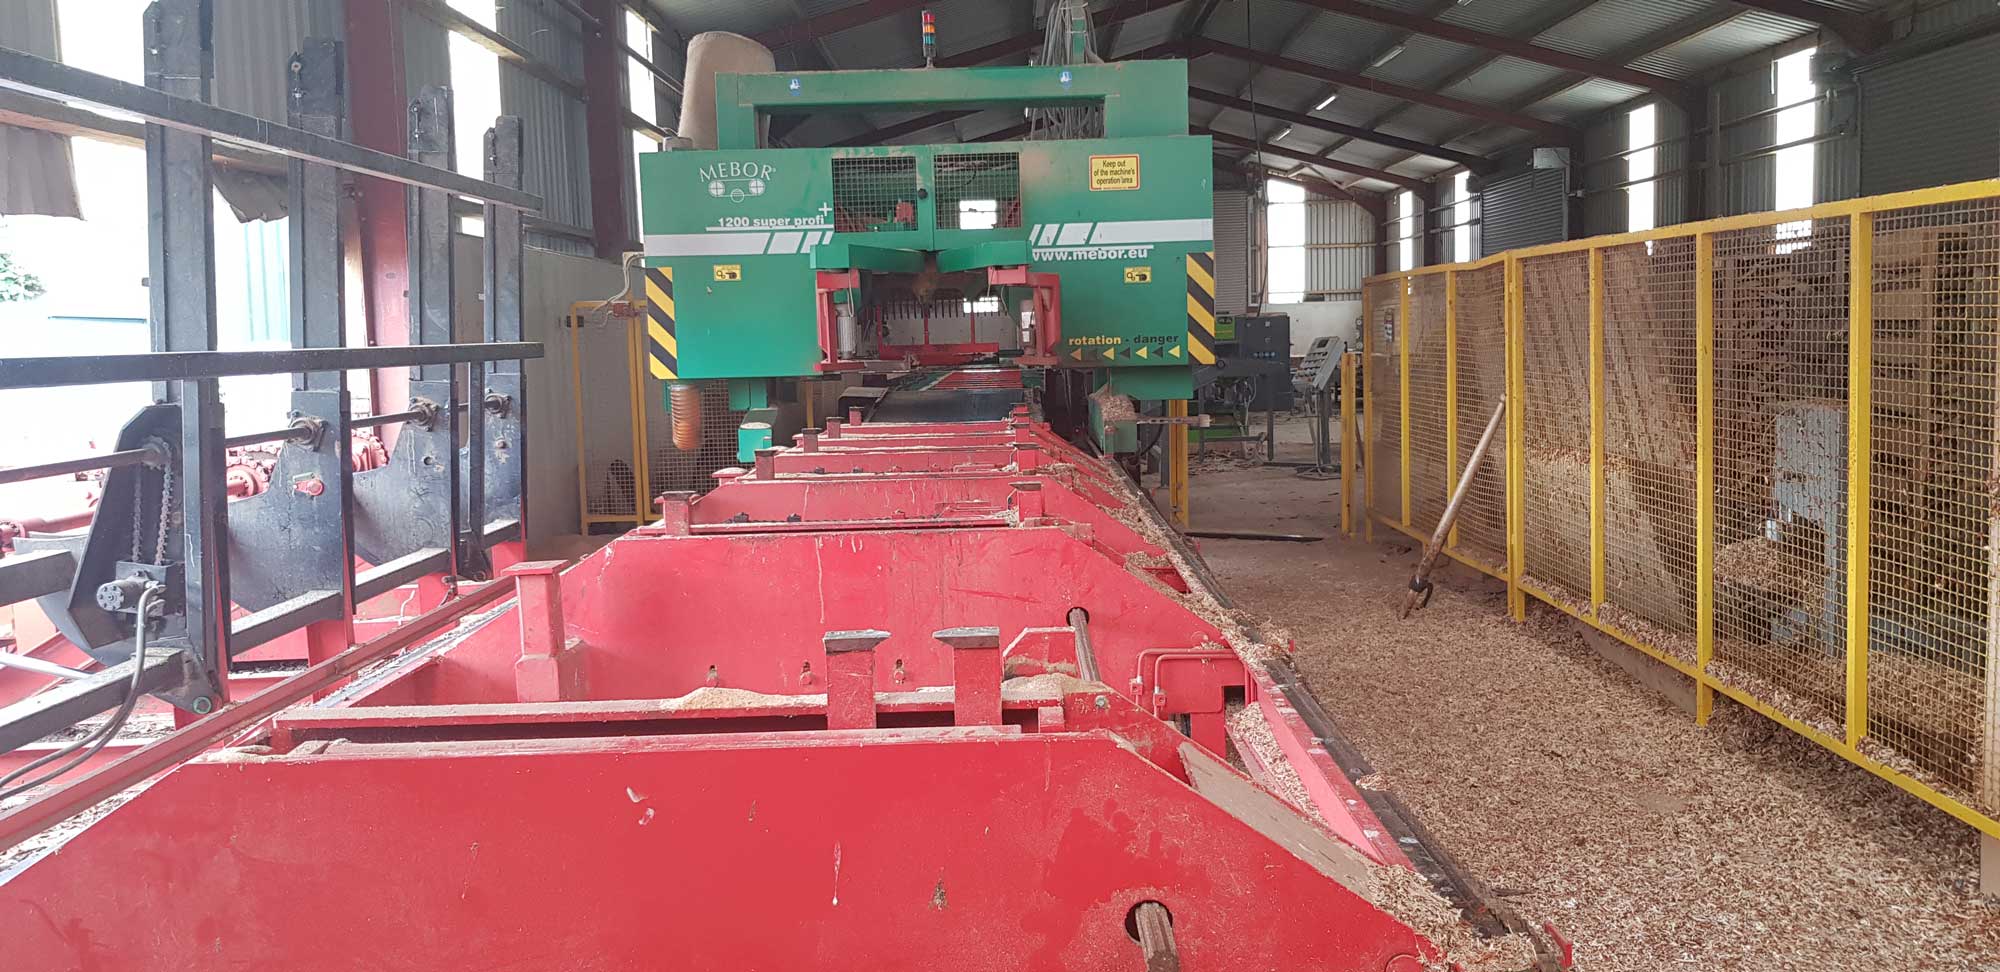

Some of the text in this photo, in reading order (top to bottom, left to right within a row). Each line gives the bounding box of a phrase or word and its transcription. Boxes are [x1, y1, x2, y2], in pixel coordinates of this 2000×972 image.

[1102, 160, 1116, 168] Keep
[1097, 177, 1120, 185] operation
[718, 216, 750, 228] 1200
[753, 216, 791, 228] super
[1068, 335, 1122, 346] rotation
[1133, 334, 1180, 345] danger
